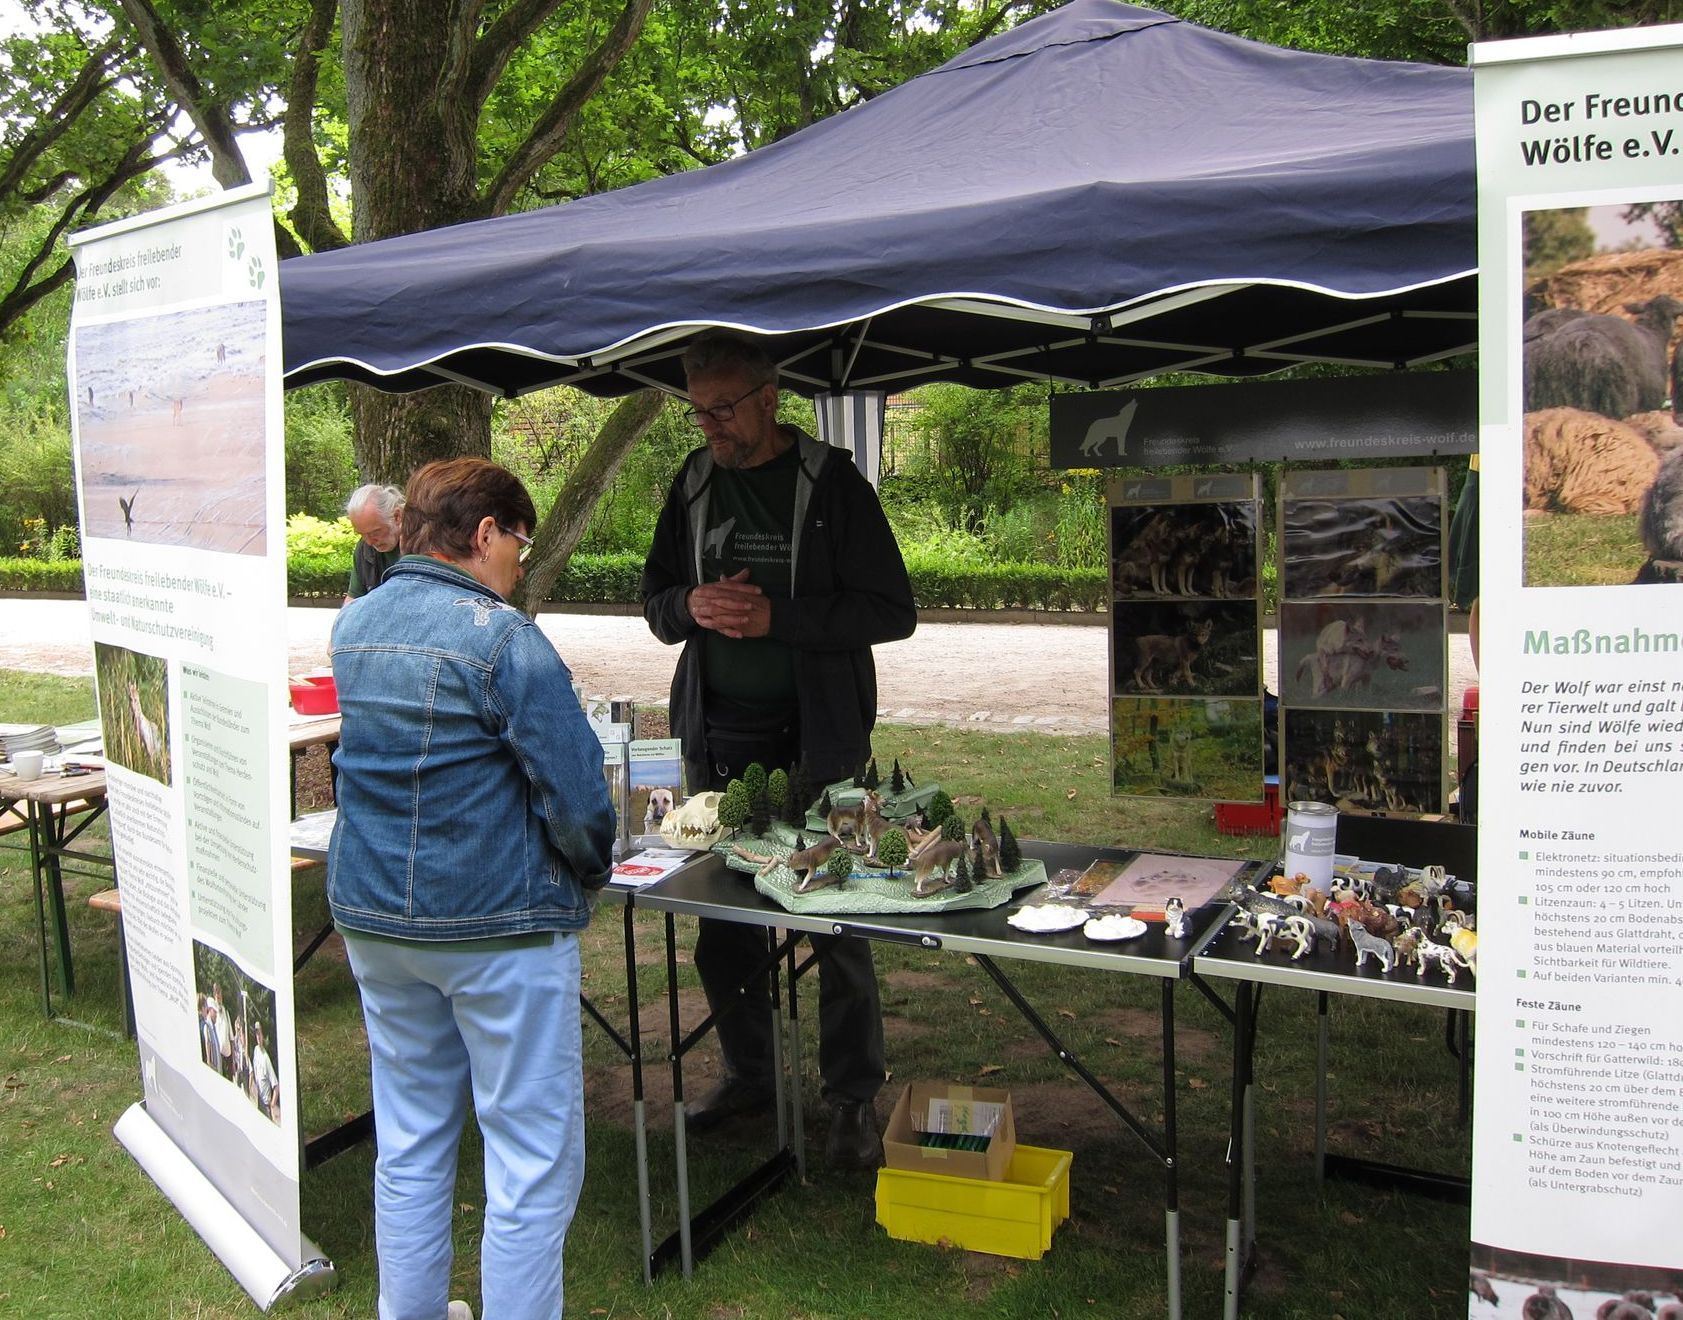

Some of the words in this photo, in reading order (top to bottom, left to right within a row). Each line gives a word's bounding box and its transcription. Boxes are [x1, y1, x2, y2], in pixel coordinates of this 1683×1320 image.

[1522, 100, 1575, 124] Der
[1521, 134, 1612, 166] Wölfe
[1623, 129, 1679, 158] e.V.
[89, 256, 135, 276] Freundeskreis
[138, 244, 182, 266] freilebender
[112, 279, 128, 296] stellt
[130, 275, 144, 292] sich
[147, 277, 160, 290] vor:
[1295, 432, 1475, 448] www.freundeskreis-wolf.de
[100, 565, 143, 585] Freundeskreis
[145, 570, 194, 591] freilebender
[212, 582, 225, 599] e.V.
[132, 592, 174, 614] anerkannte
[1523, 628, 1683, 655] Maßnahm
[1522, 681, 1548, 694] Der
[1555, 680, 1590, 696] Wolf
[1595, 683, 1623, 693] war
[1628, 681, 1666, 692] einst
[1521, 703, 1543, 713] rer
[1548, 701, 1608, 713] Tierwelt
[1613, 700, 1641, 713] und
[1646, 700, 1676, 715] galt
[1521, 721, 1552, 733] Nun
[1559, 721, 1592, 733] sind
[1599, 720, 1641, 736] Wölfe
[1520, 741, 1550, 752] und
[1557, 741, 1606, 756] finden
[1614, 740, 1638, 752] bei
[1644, 742, 1672, 752] uns
[1520, 762, 1548, 775] gen
[1553, 763, 1579, 772] vor.
[1584, 761, 1598, 772] In
[1520, 781, 1546, 792] wie
[1551, 780, 1574, 792] nie
[1578, 783, 1623, 792] zuvor.
[1519, 830, 1558, 840] Mobile
[1562, 831, 1595, 840] Zäune
[1536, 852, 1600, 862] Elektronetz:
[1536, 868, 1598, 878] mindestens
[1603, 871, 1614, 879] 90
[1618, 870, 1637, 878] cm,
[1536, 884, 1553, 893] 105
[1576, 884, 1600, 892] oder
[1626, 885, 1640, 893] cm
[1644, 884, 1670, 893] hoch
[1535, 897, 1597, 908] Litzenzaun:
[1600, 901, 1606, 909] 4
[1619, 901, 1624, 909] 5
[1628, 899, 1664, 909] Litzen.
[1535, 912, 1590, 922] höchstens
[1594, 915, 1606, 923] 20
[1610, 915, 1624, 923] cm
[1534, 927, 1591, 937] bestehend
[1595, 930, 1613, 938] aus
[1534, 944, 1553, 952] aus
[1557, 943, 1592, 952] blauen
[1596, 944, 1640, 953] Material
[1534, 957, 1598, 968] Sichtbarkeit
[1602, 958, 1616, 968] für
[1619, 959, 1671, 970] Wildtiere.
[1533, 972, 1550, 981] Auf
[1555, 972, 1590, 983] beiden
[1594, 974, 1645, 984] Varianten
[1648, 976, 1671, 985] min.
[1675, 978, 1683, 986] 4
[1516, 998, 1544, 1009] Feste
[1548, 1000, 1581, 1011] Zäune
[1532, 1021, 1549, 1031] Für
[1553, 1022, 1588, 1033] Schafe
[1592, 1024, 1611, 1034] und
[1615, 1025, 1651, 1036] Ziegen
[1532, 1036, 1594, 1048] mindestens
[1629, 1042, 1647, 1051] 140
[1650, 1043, 1665, 1051] cm
[1532, 1050, 1582, 1061] Vorschrift
[1586, 1053, 1600, 1062] für
[1604, 1054, 1663, 1066] Gatterwild:
[1531, 1064, 1611, 1078] Stromführende
[1615, 1067, 1639, 1079] Litze
[1531, 1078, 1585, 1092] höchstens
[1605, 1085, 1620, 1093] cm
[1624, 1084, 1648, 1094] über
[1652, 1086, 1675, 1096] dem
[1530, 1094, 1553, 1103] eine
[1557, 1096, 1595, 1107] weitere
[1599, 1098, 1679, 1111] stromführende
[1530, 1107, 1539, 1116] in
[1565, 1112, 1579, 1120] cm
[1583, 1113, 1611, 1122] Höhe
[1614, 1114, 1648, 1124] außen
[1651, 1117, 1668, 1126] vor
[1530, 1122, 1549, 1132] (als
[1552, 1123, 1669, 1141] Überwindungsschutz)
[1530, 1135, 1571, 1148] Schürze
[1575, 1141, 1593, 1150] aus
[1597, 1141, 1679, 1157] Knotengeflecht
[1529, 1150, 1557, 1161] Höhe
[1560, 1155, 1576, 1163] am
[1579, 1155, 1605, 1165] Zaun
[1608, 1156, 1656, 1169] befestigt
[1660, 1160, 1680, 1171] und
[1529, 1165, 1546, 1174] auf
[1549, 1166, 1571, 1177] dem
[1575, 1169, 1608, 1179] Boden
[1612, 1172, 1628, 1180] vor
[1632, 1173, 1656, 1184] dem
[1529, 1178, 1547, 1188] (als
[1551, 1180, 1642, 1197] Untergrabschutz)
